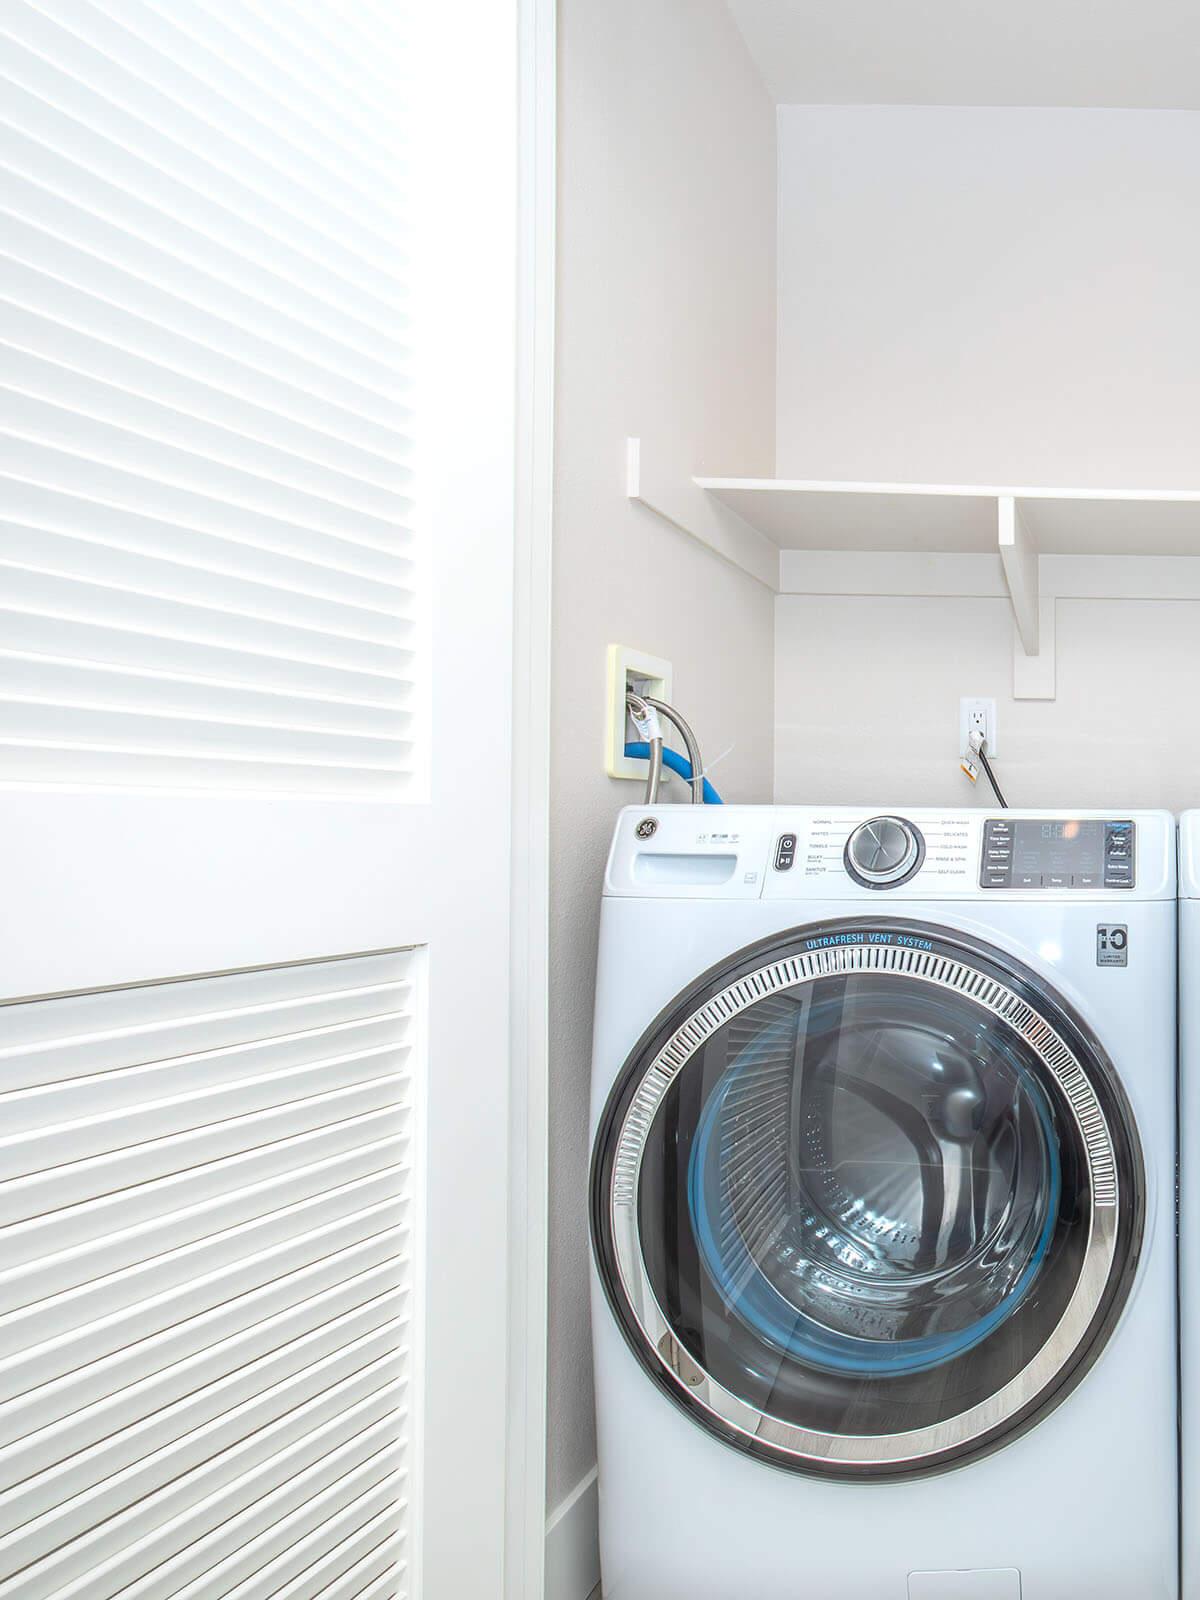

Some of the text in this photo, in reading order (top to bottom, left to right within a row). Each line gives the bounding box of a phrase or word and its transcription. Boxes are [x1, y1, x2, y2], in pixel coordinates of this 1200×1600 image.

[806, 933, 933, 950] ULTRAFRESH VENT SYSTEM
[1097, 928, 1127, 950] 10
